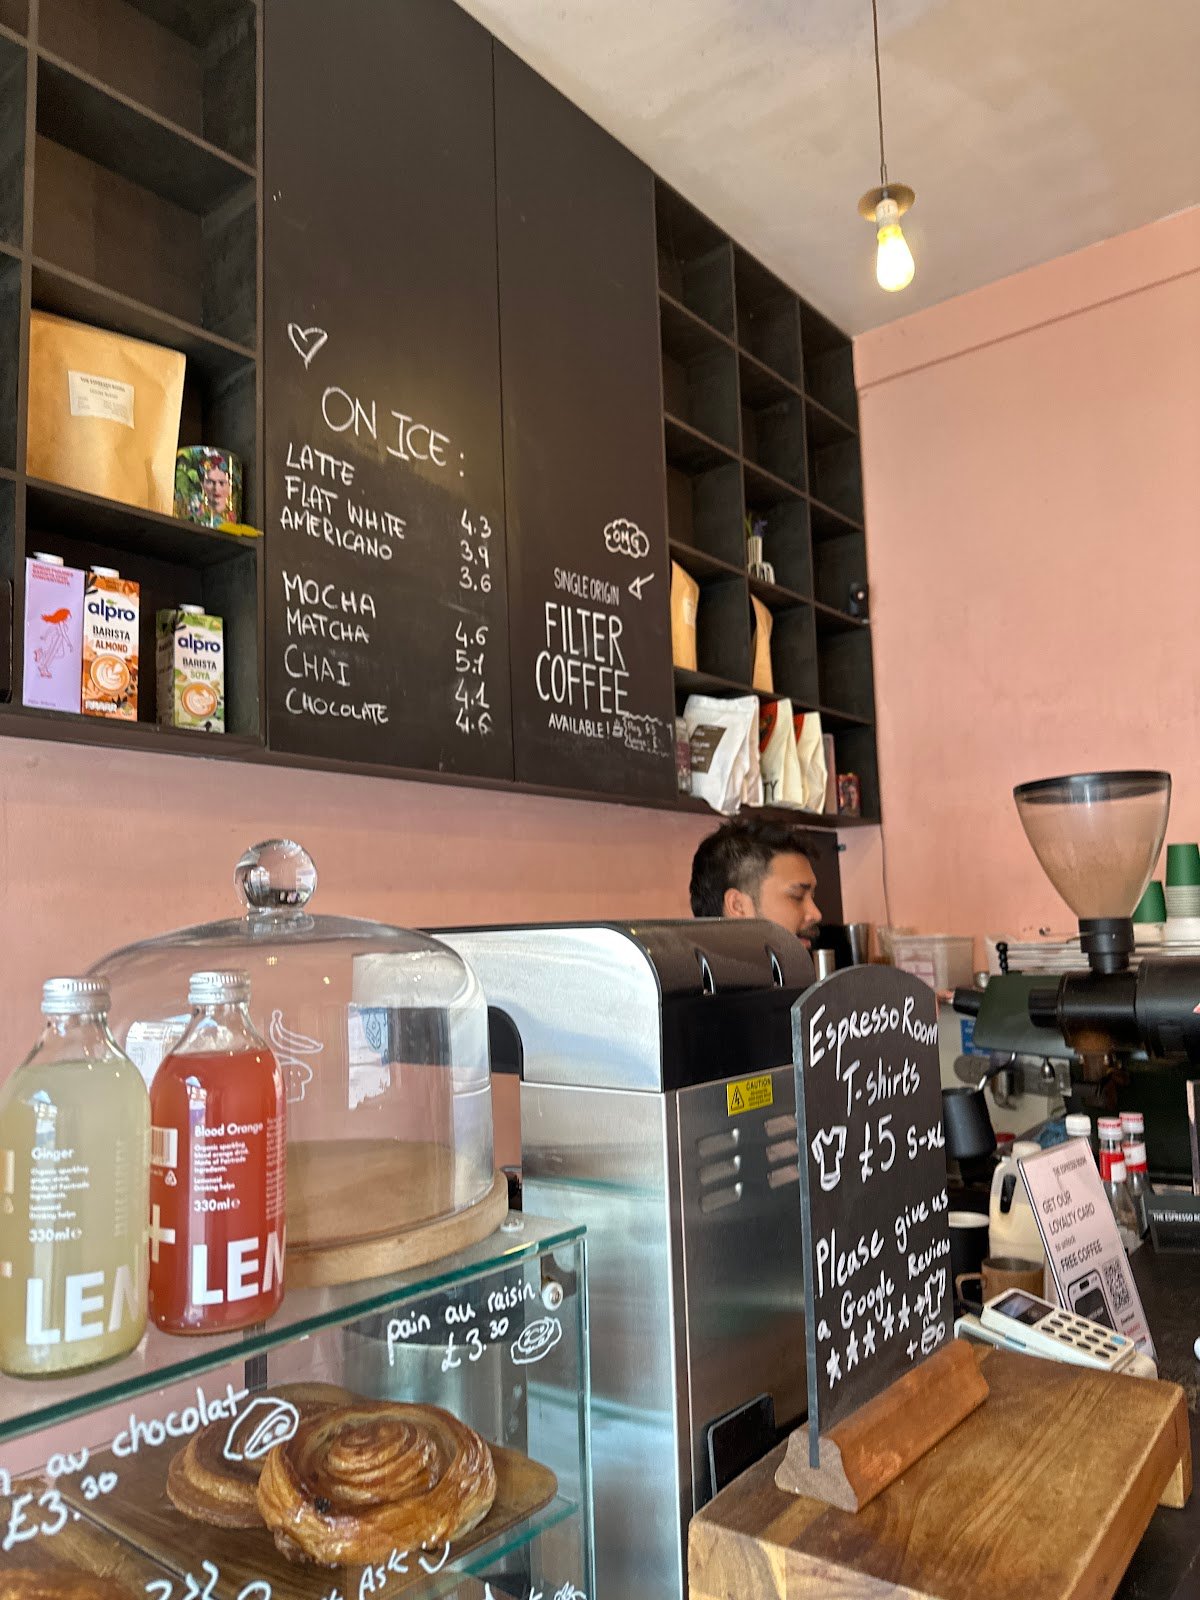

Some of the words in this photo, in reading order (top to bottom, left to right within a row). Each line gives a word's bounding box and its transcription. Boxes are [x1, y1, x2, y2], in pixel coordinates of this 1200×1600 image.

[321, 386, 378, 440] ON
[286, 442, 355, 486] LATTE
[460, 508, 492, 539] 4.3
[284, 475, 338, 515] FLAT
[347, 498, 407, 540] WHITE
[459, 539, 490, 569] 3.9
[280, 505, 393, 560] AMERICANO
[459, 566, 492, 593] 3.6
[553, 566, 589, 600] SINGLE
[589, 578, 620, 606] ORIGIN
[88, 598, 136, 622] alpro
[281, 570, 377, 619] MOCHA
[455, 621, 489, 648] 4.6
[286, 606, 370, 644] MATCHA
[92, 625, 131, 641] BARISTA
[95, 639, 129, 653] ALMOND
[177, 633, 222, 655] alpro
[545, 601, 626, 671] FILTER
[182, 656, 217, 671] BARISTA
[190, 670, 210, 681] SOYA
[284, 643, 351, 688] CHAI
[454, 677, 490, 710] 4.1
[535, 650, 630, 717] COFFEE
[285, 687, 389, 726] CHOCOLATE
[455, 708, 493, 735] 4.6
[746, 1078, 771, 1092] CAUTION
[194, 1123, 225, 1137] Blood
[226, 1122, 264, 1135] Orange
[858, 1113, 897, 1183] £5
[31, 1147, 75, 1162] Ginger
[194, 1197, 230, 1212] 330ml
[1042, 1195, 1057, 1215] GET
[1056, 1190, 1073, 1209] OUR
[1048, 1207, 1078, 1236] LOYALTY
[1077, 1202, 1096, 1221] CARD
[1153, 1212, 1164, 1222] THE
[1164, 1212, 1193, 1222] ESPRESSO
[29, 1226, 70, 1243] 330ml
[816, 1228, 885, 1299] Please
[894, 1201, 929, 1254] give
[931, 1187, 949, 1212] us
[1060, 1252, 1079, 1273] FREE
[1077, 1238, 1102, 1264] COFFEE
[387, 1310, 431, 1366] pain
[444, 1302, 476, 1324] au
[487, 1278, 536, 1313] raisin
[817, 1318, 832, 1342] a
[840, 1269, 895, 1330] Google
[111, 1383, 250, 1457] chocolat
